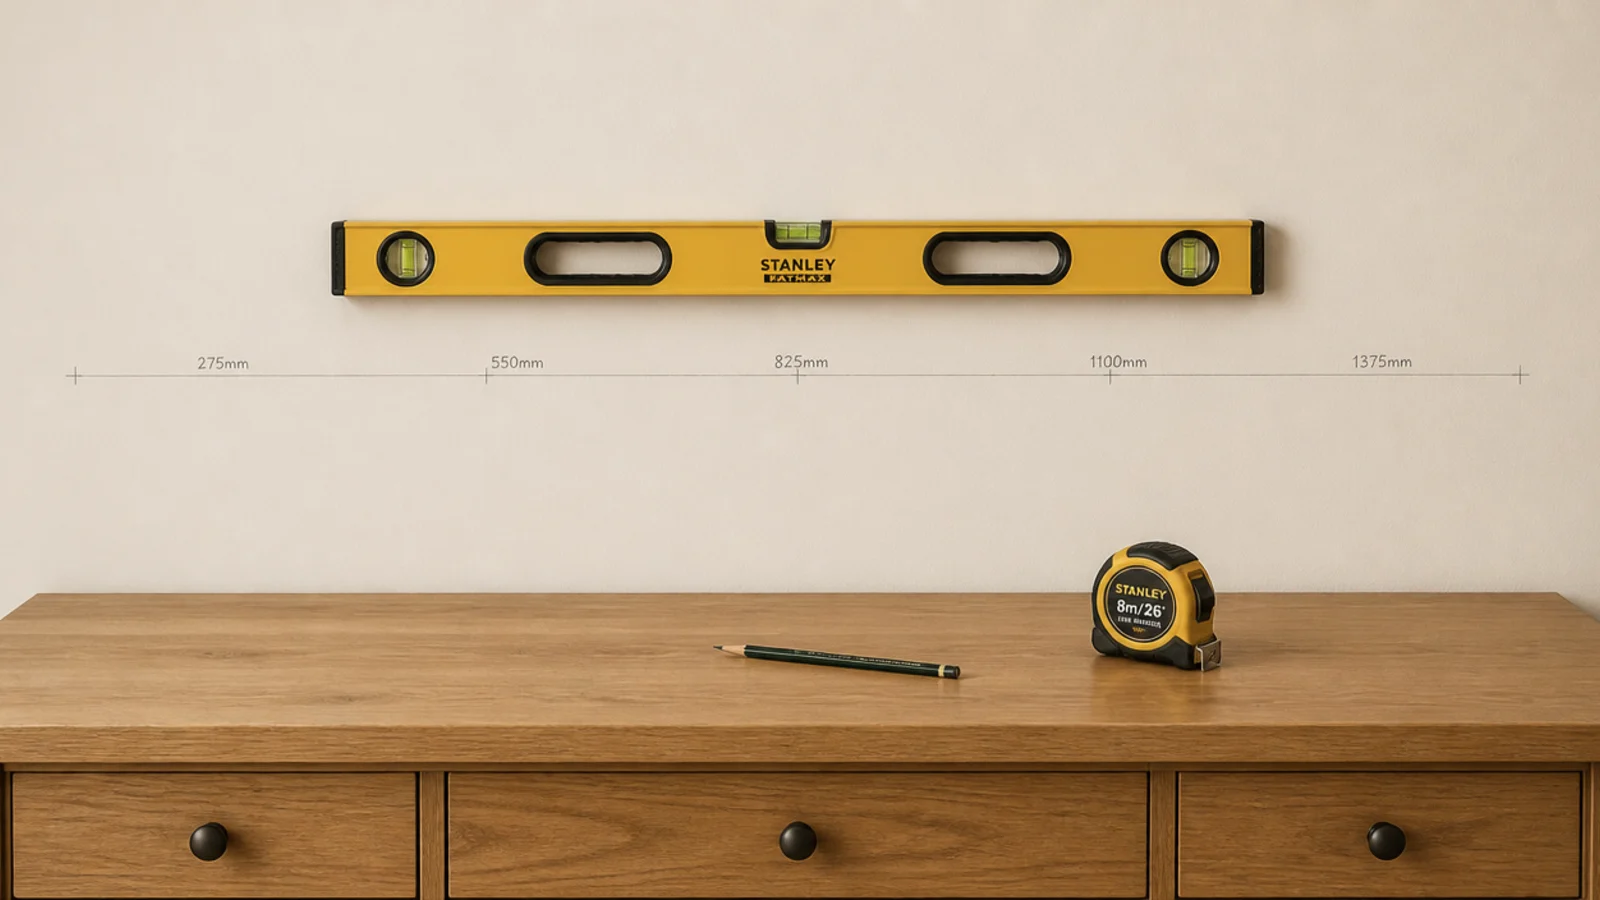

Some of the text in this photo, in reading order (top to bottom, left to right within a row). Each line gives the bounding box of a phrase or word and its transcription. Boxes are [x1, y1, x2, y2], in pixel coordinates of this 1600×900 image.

[761, 259, 836, 271] STANLEY
[198, 356, 249, 370] 275mm
[491, 356, 544, 369] 550mm
[775, 354, 828, 369] 825mm
[1090, 354, 1147, 368] 1100mm
[1353, 354, 1412, 368] 1375mm
[1115, 583, 1167, 600] STANLEY
